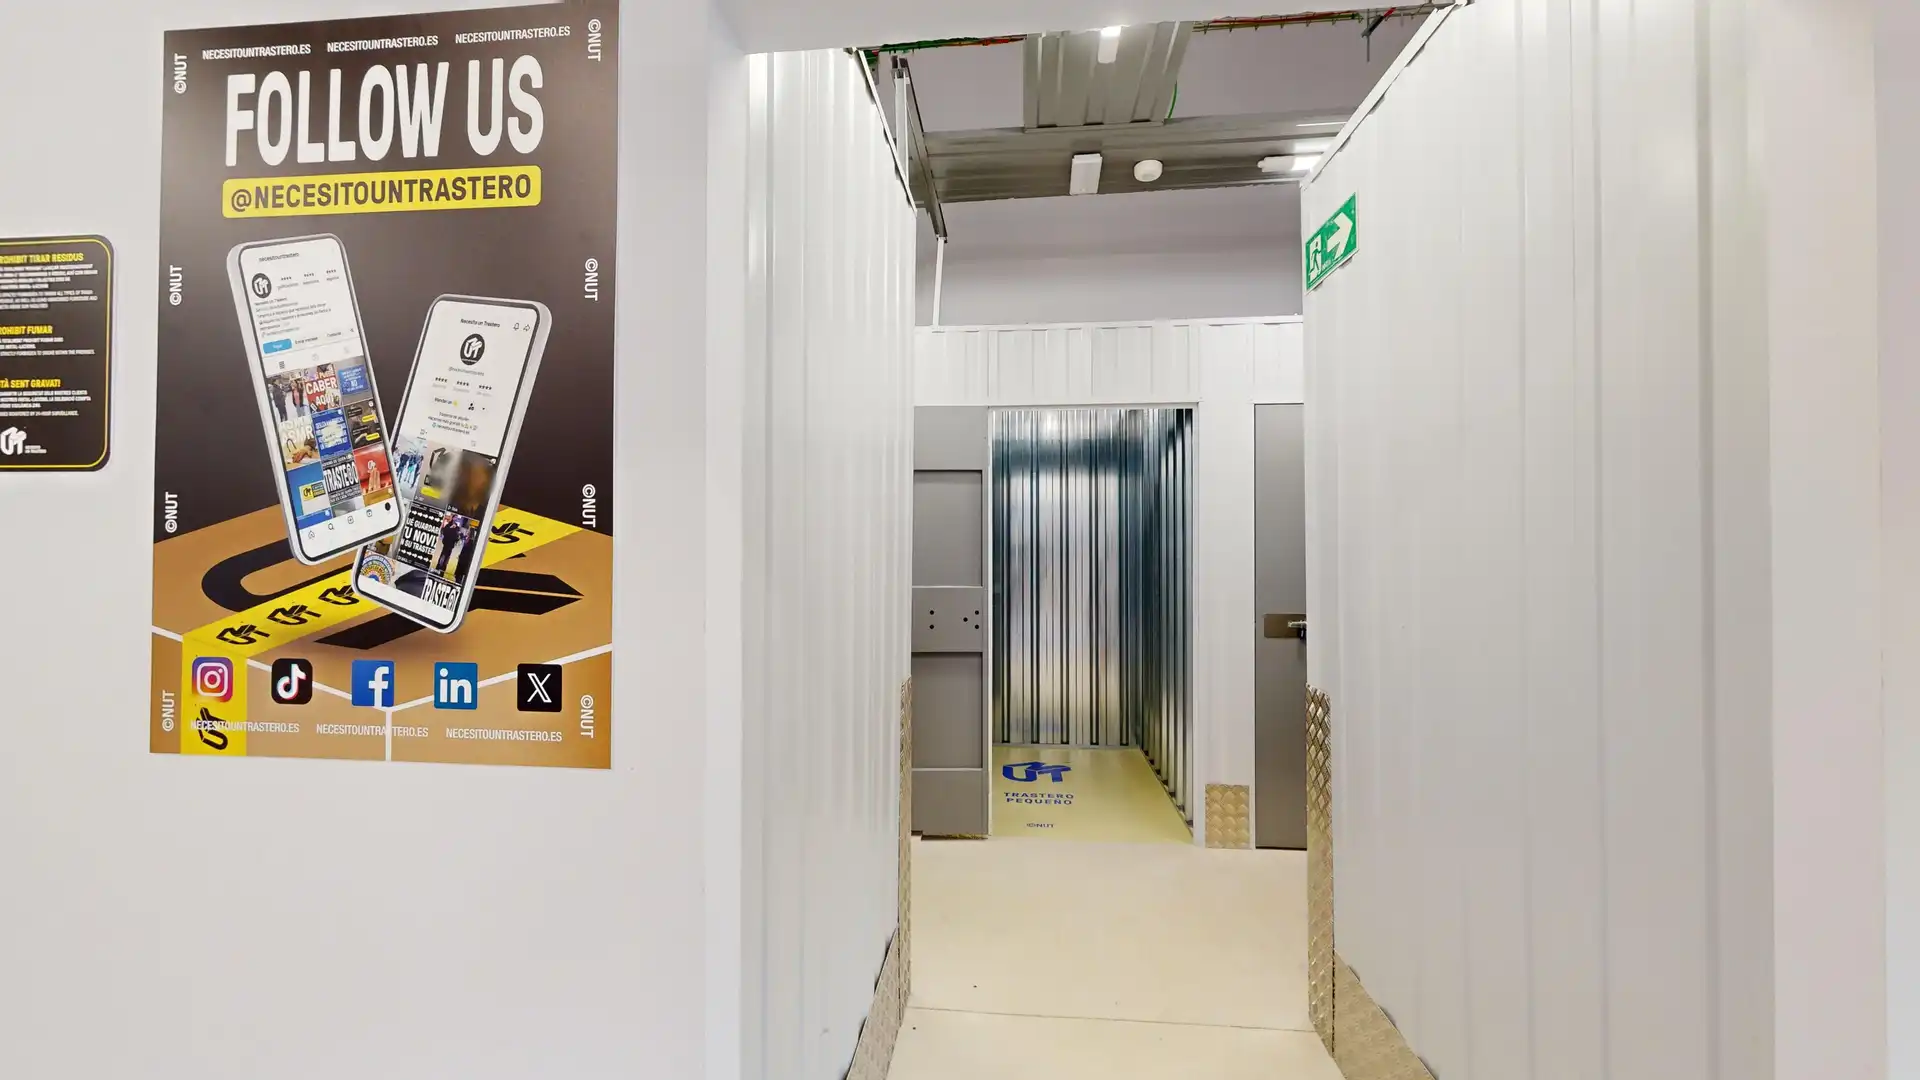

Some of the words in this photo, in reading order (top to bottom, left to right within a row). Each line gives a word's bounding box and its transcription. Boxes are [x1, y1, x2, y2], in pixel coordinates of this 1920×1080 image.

[327, 35, 438, 53] NECESITOUNTRASTERO.ES
[455, 26, 570, 44] NECESITOUNTRASTERO.ES
[202, 44, 311, 60] NECESITOUNTRASTERO.ES
[225, 61, 450, 167] FOLLOW
[467, 54, 544, 157] US
[230, 173, 532, 213] @NECESITOUNTRASTERO
[27, 325, 53, 335] FUMAR
[10, 379, 30, 388] SENT
[30, 378, 61, 388] GRAVAT!
[305, 377, 338, 395] CABER
[413, 529, 437, 549] NOVI
[316, 723, 429, 737] NECESITOUNTRATERO.ES
[446, 727, 562, 742] NECESITOUNTRASTERO.ES
